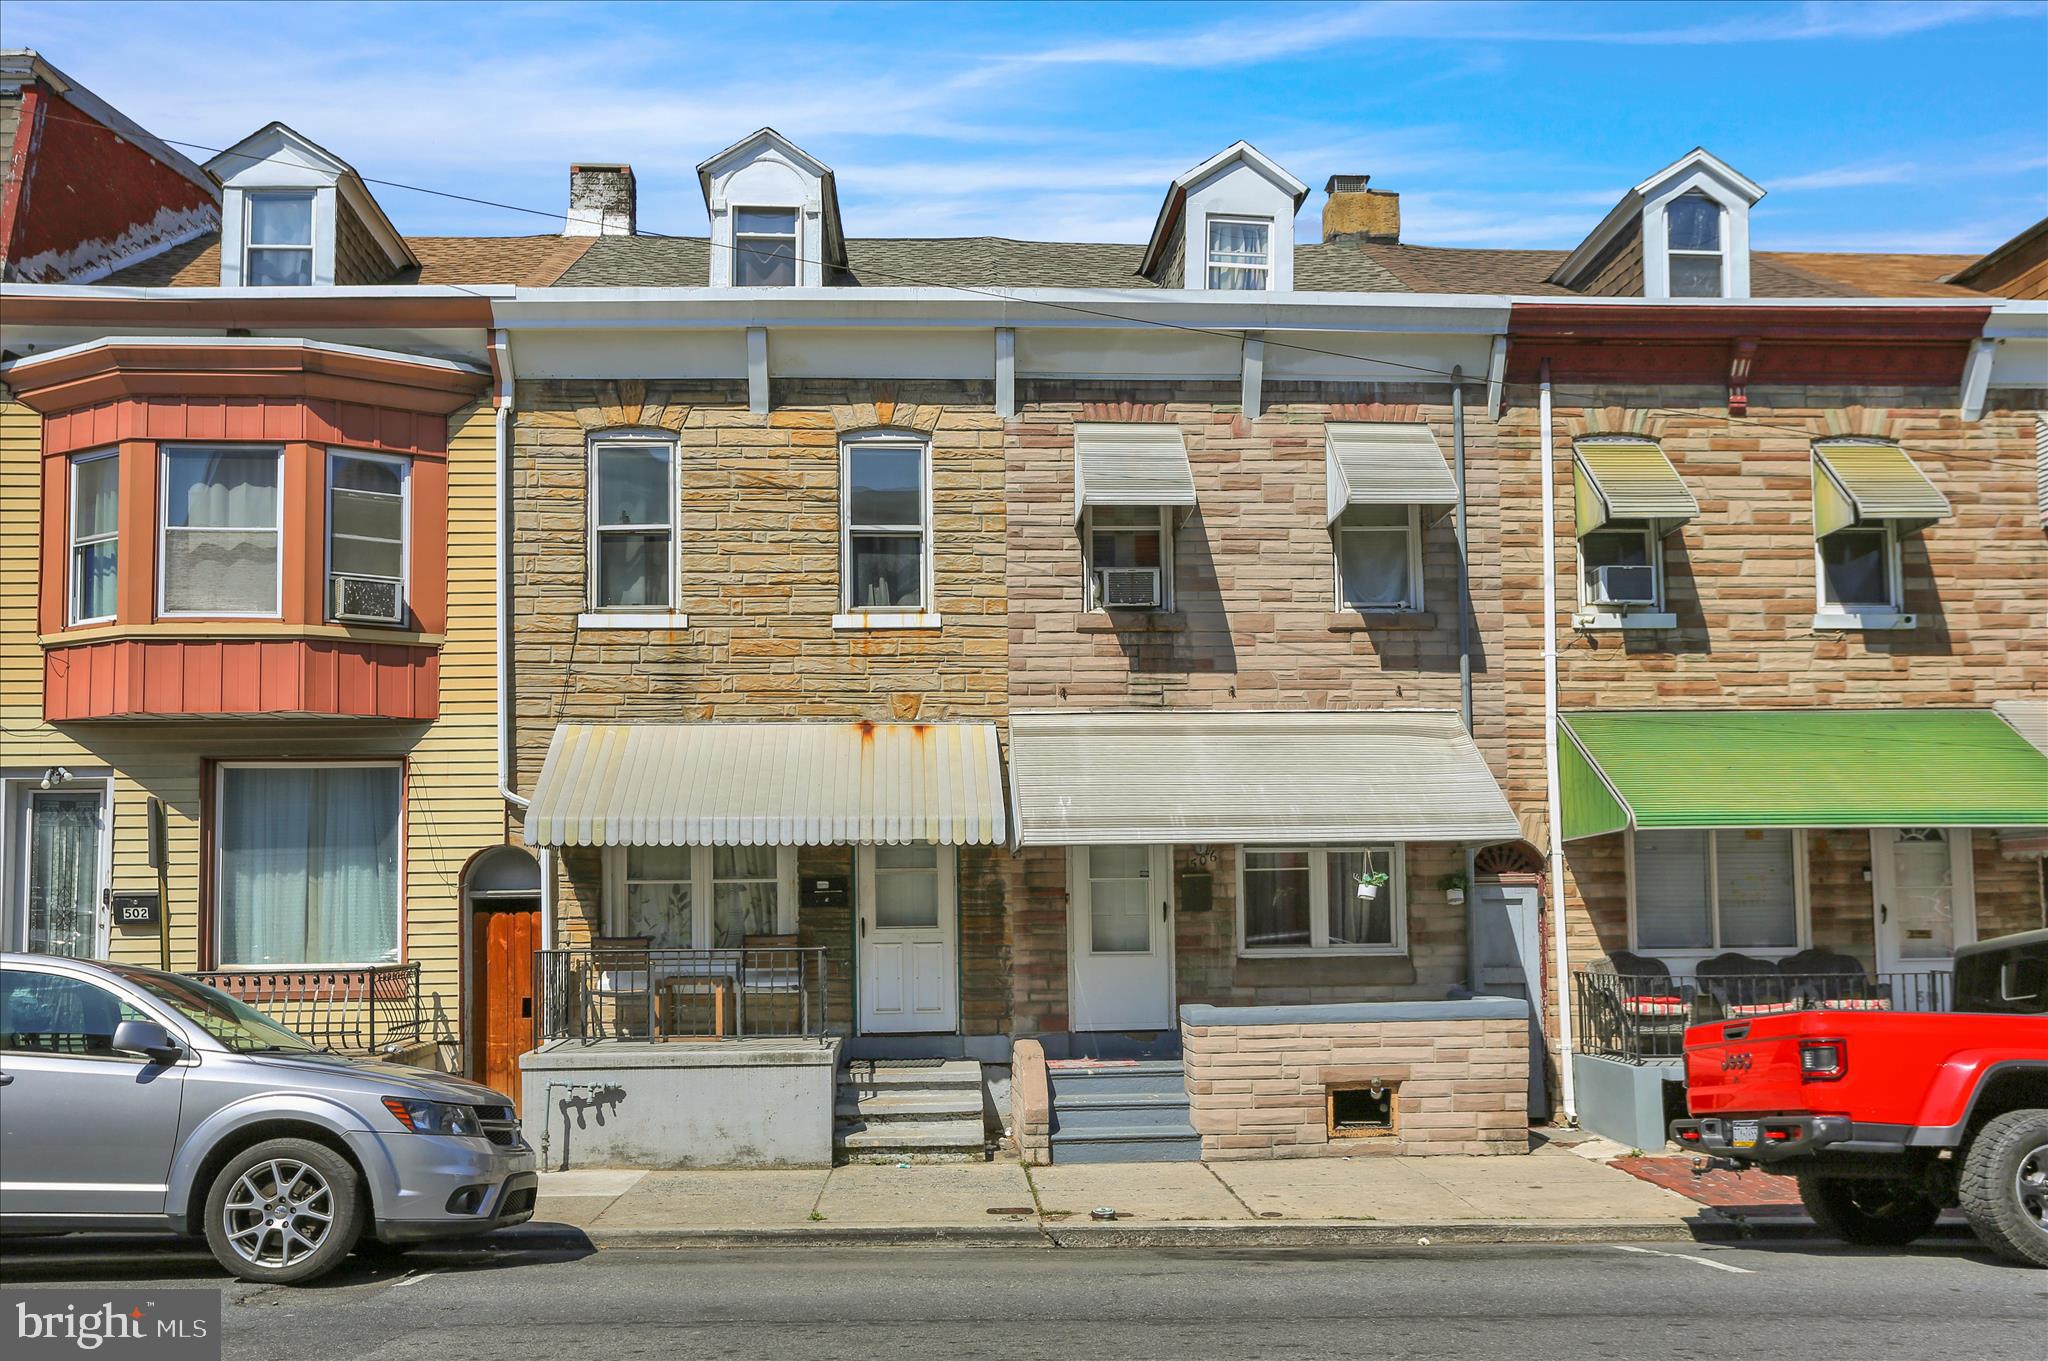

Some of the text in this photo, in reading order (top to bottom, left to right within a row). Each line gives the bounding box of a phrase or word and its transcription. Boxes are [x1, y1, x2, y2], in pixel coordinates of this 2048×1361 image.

[1190, 849, 1217, 867] 506
[124, 908, 148, 919] 502
[1721, 1049, 1753, 1072] Jeep
